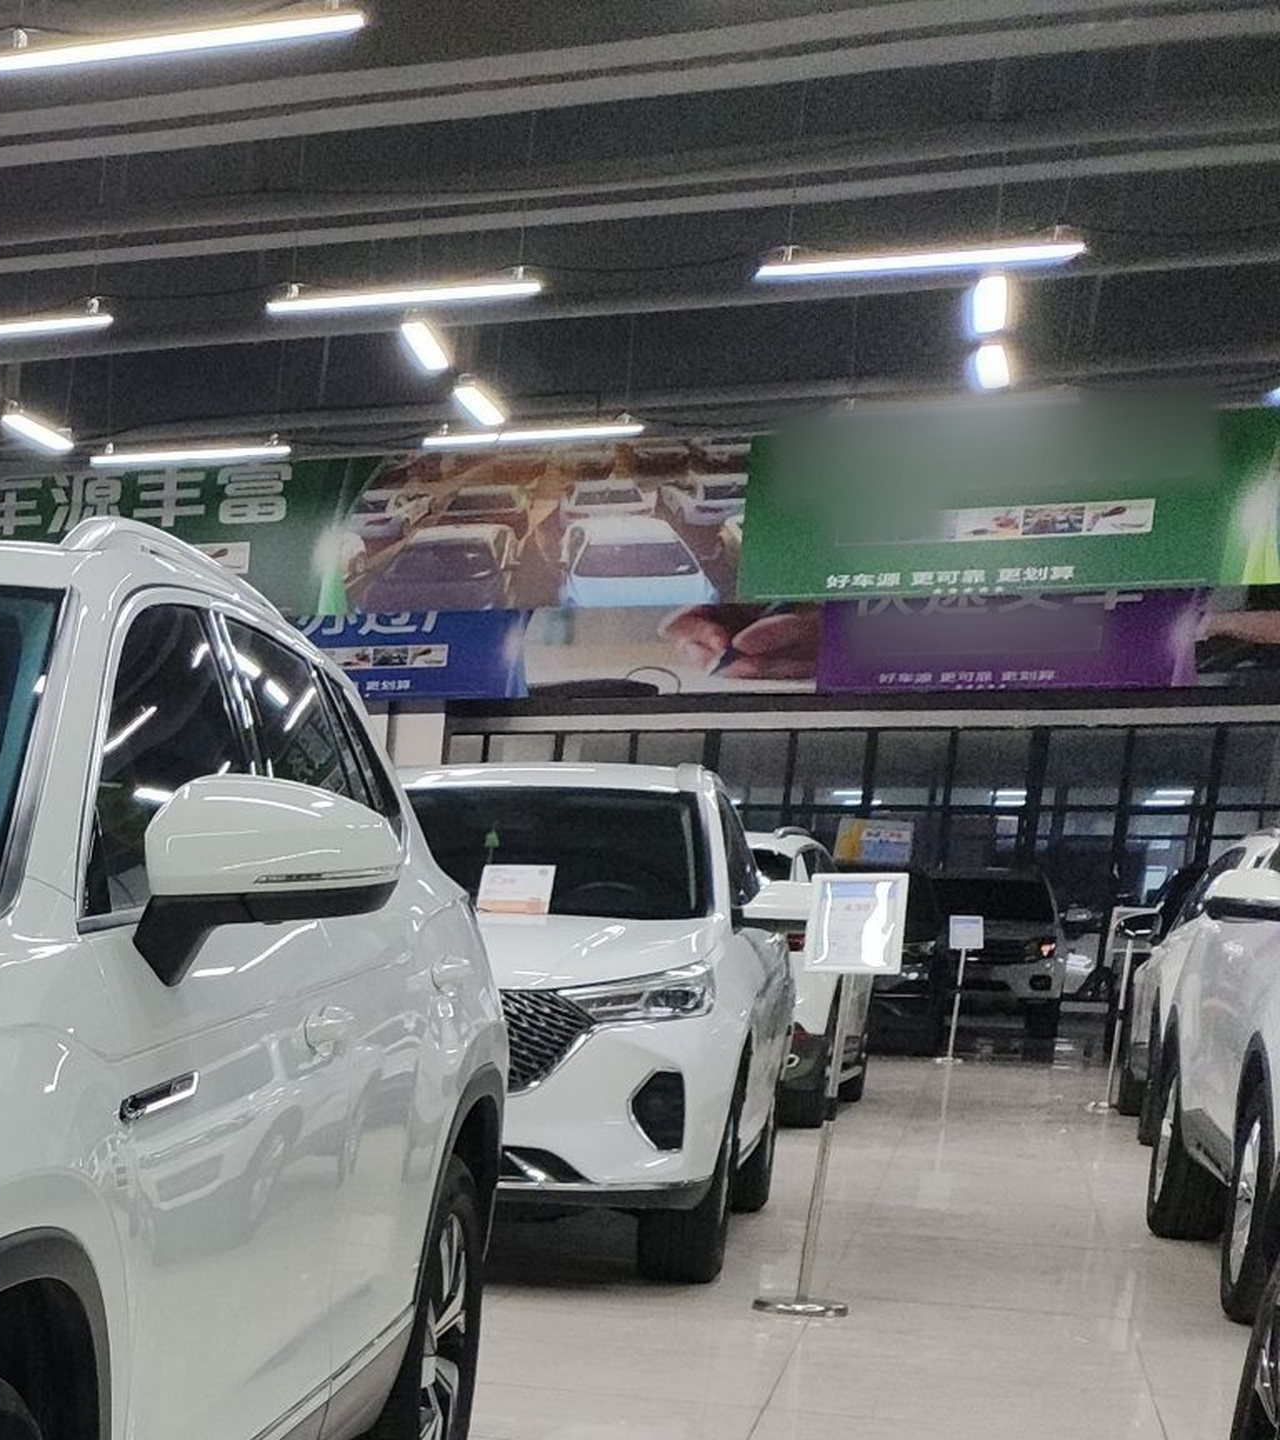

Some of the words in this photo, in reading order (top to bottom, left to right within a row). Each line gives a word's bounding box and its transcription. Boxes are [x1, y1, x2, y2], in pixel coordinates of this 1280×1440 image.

[825, 572, 902, 589] 好车源
[910, 569, 987, 587] 更可靠
[997, 565, 1076, 584] 更划算
